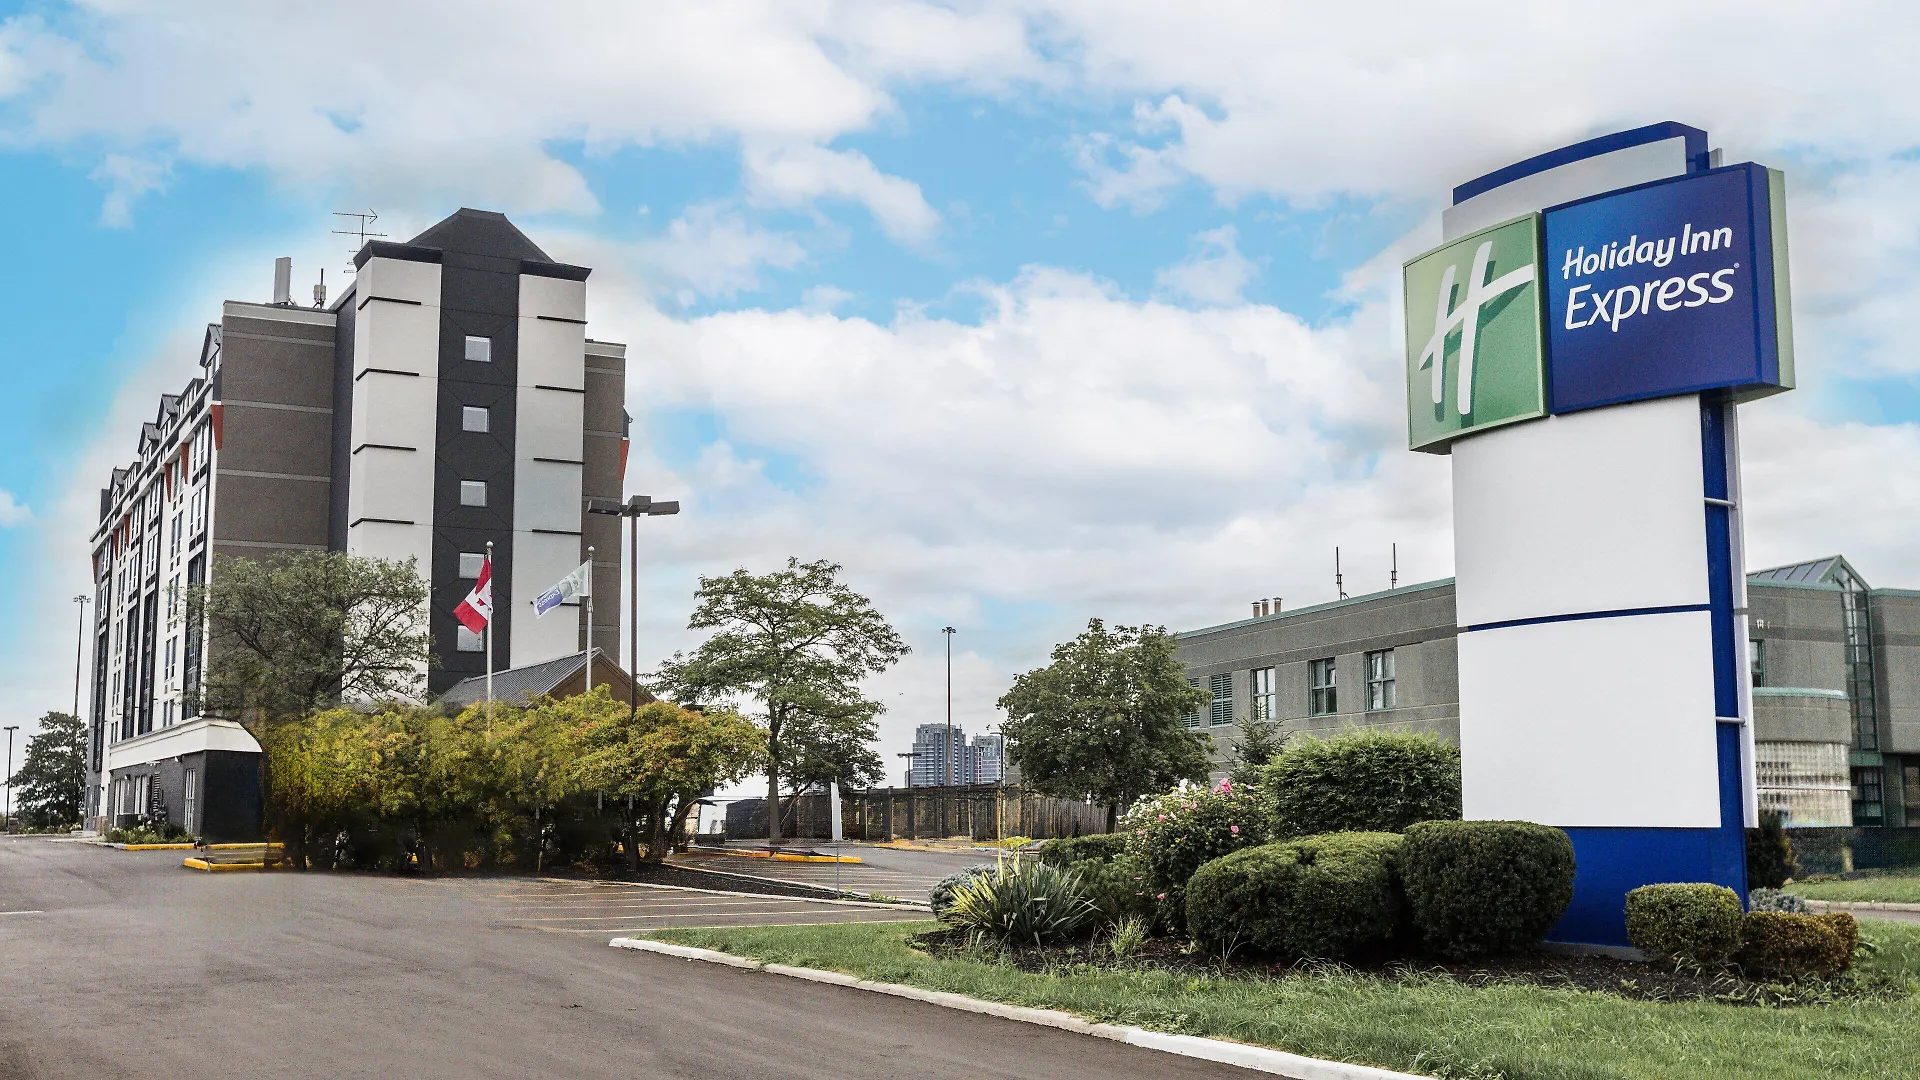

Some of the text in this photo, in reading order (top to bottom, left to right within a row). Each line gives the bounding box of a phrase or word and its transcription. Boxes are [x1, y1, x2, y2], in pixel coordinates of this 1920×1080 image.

[1561, 223, 1734, 280] Holiday Inn
[1565, 268, 1736, 333] Express
